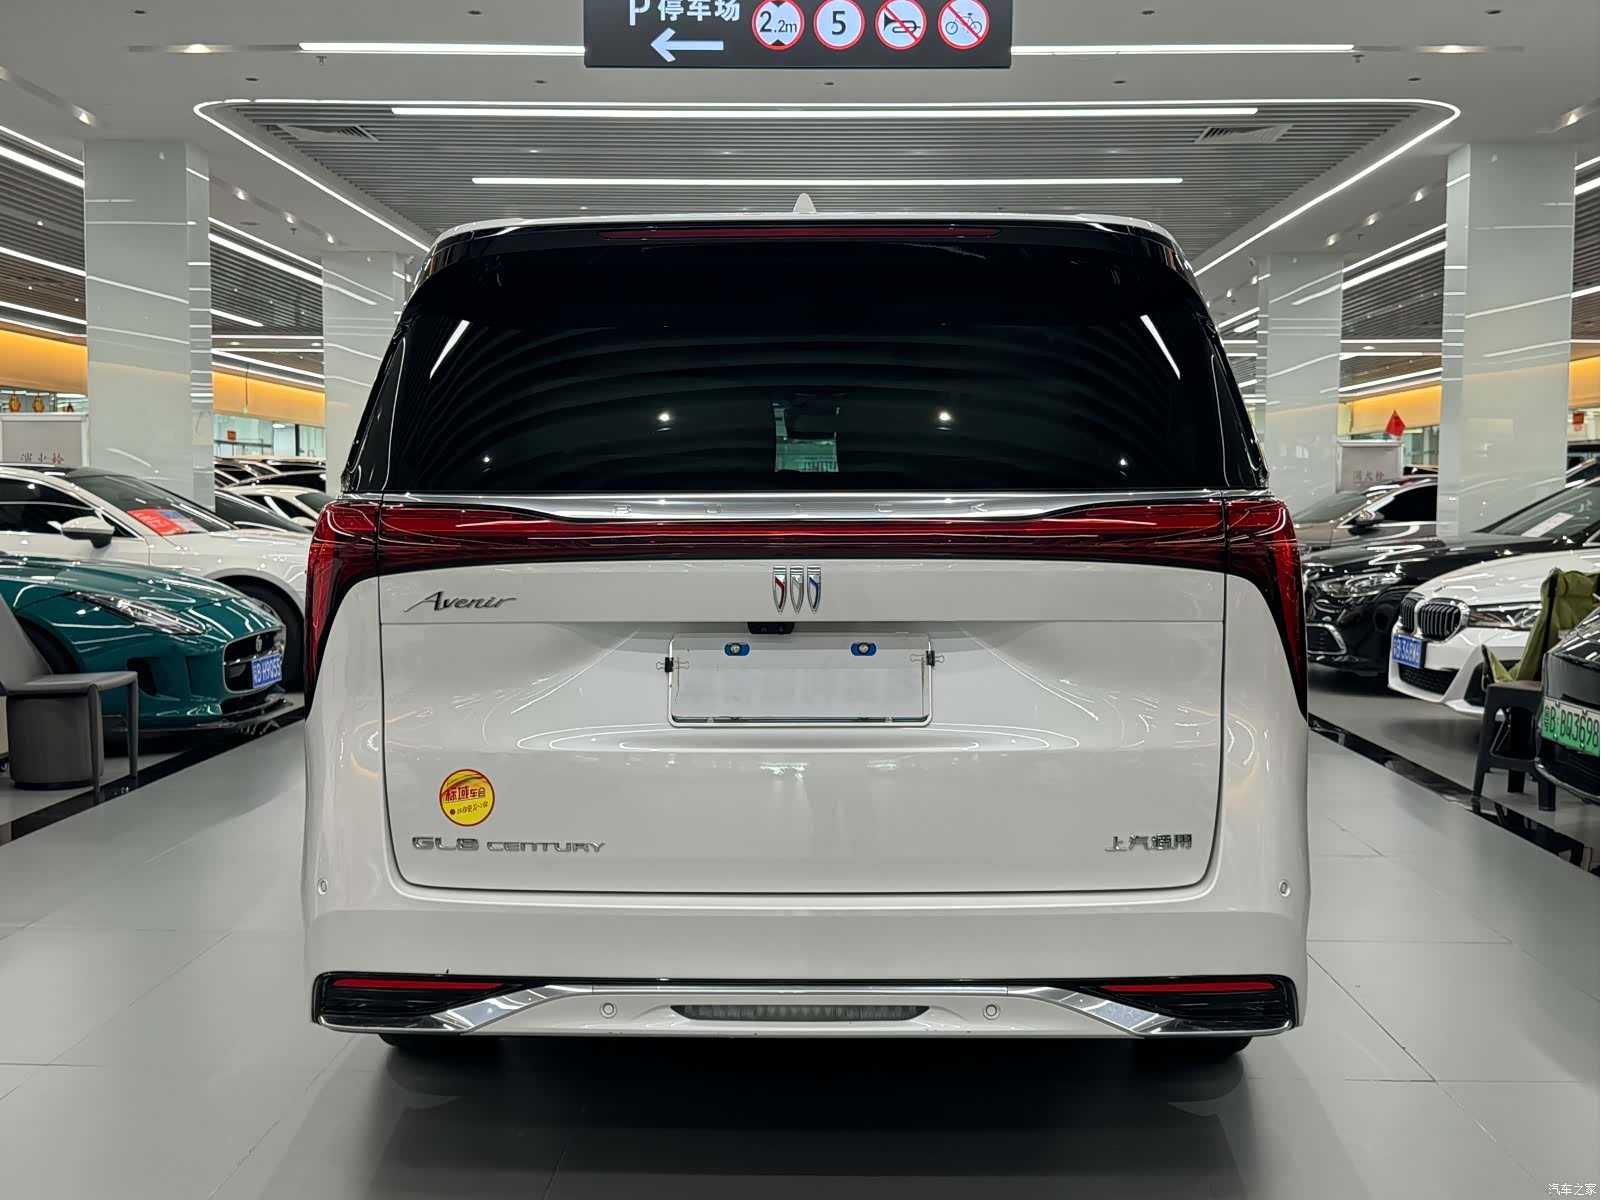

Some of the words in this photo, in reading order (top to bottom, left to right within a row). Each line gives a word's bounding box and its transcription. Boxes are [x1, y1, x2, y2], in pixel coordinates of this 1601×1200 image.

[657, 0, 740, 21] 停车场
[760, 10, 797, 33] 2.2m
[831, 10, 846, 35] 5
[403, 591, 517, 612] Avenir
[412, 837, 480, 851] GL8
[486, 841, 606, 853] CENTURY
[1104, 834, 1192, 851] 上汽通用
